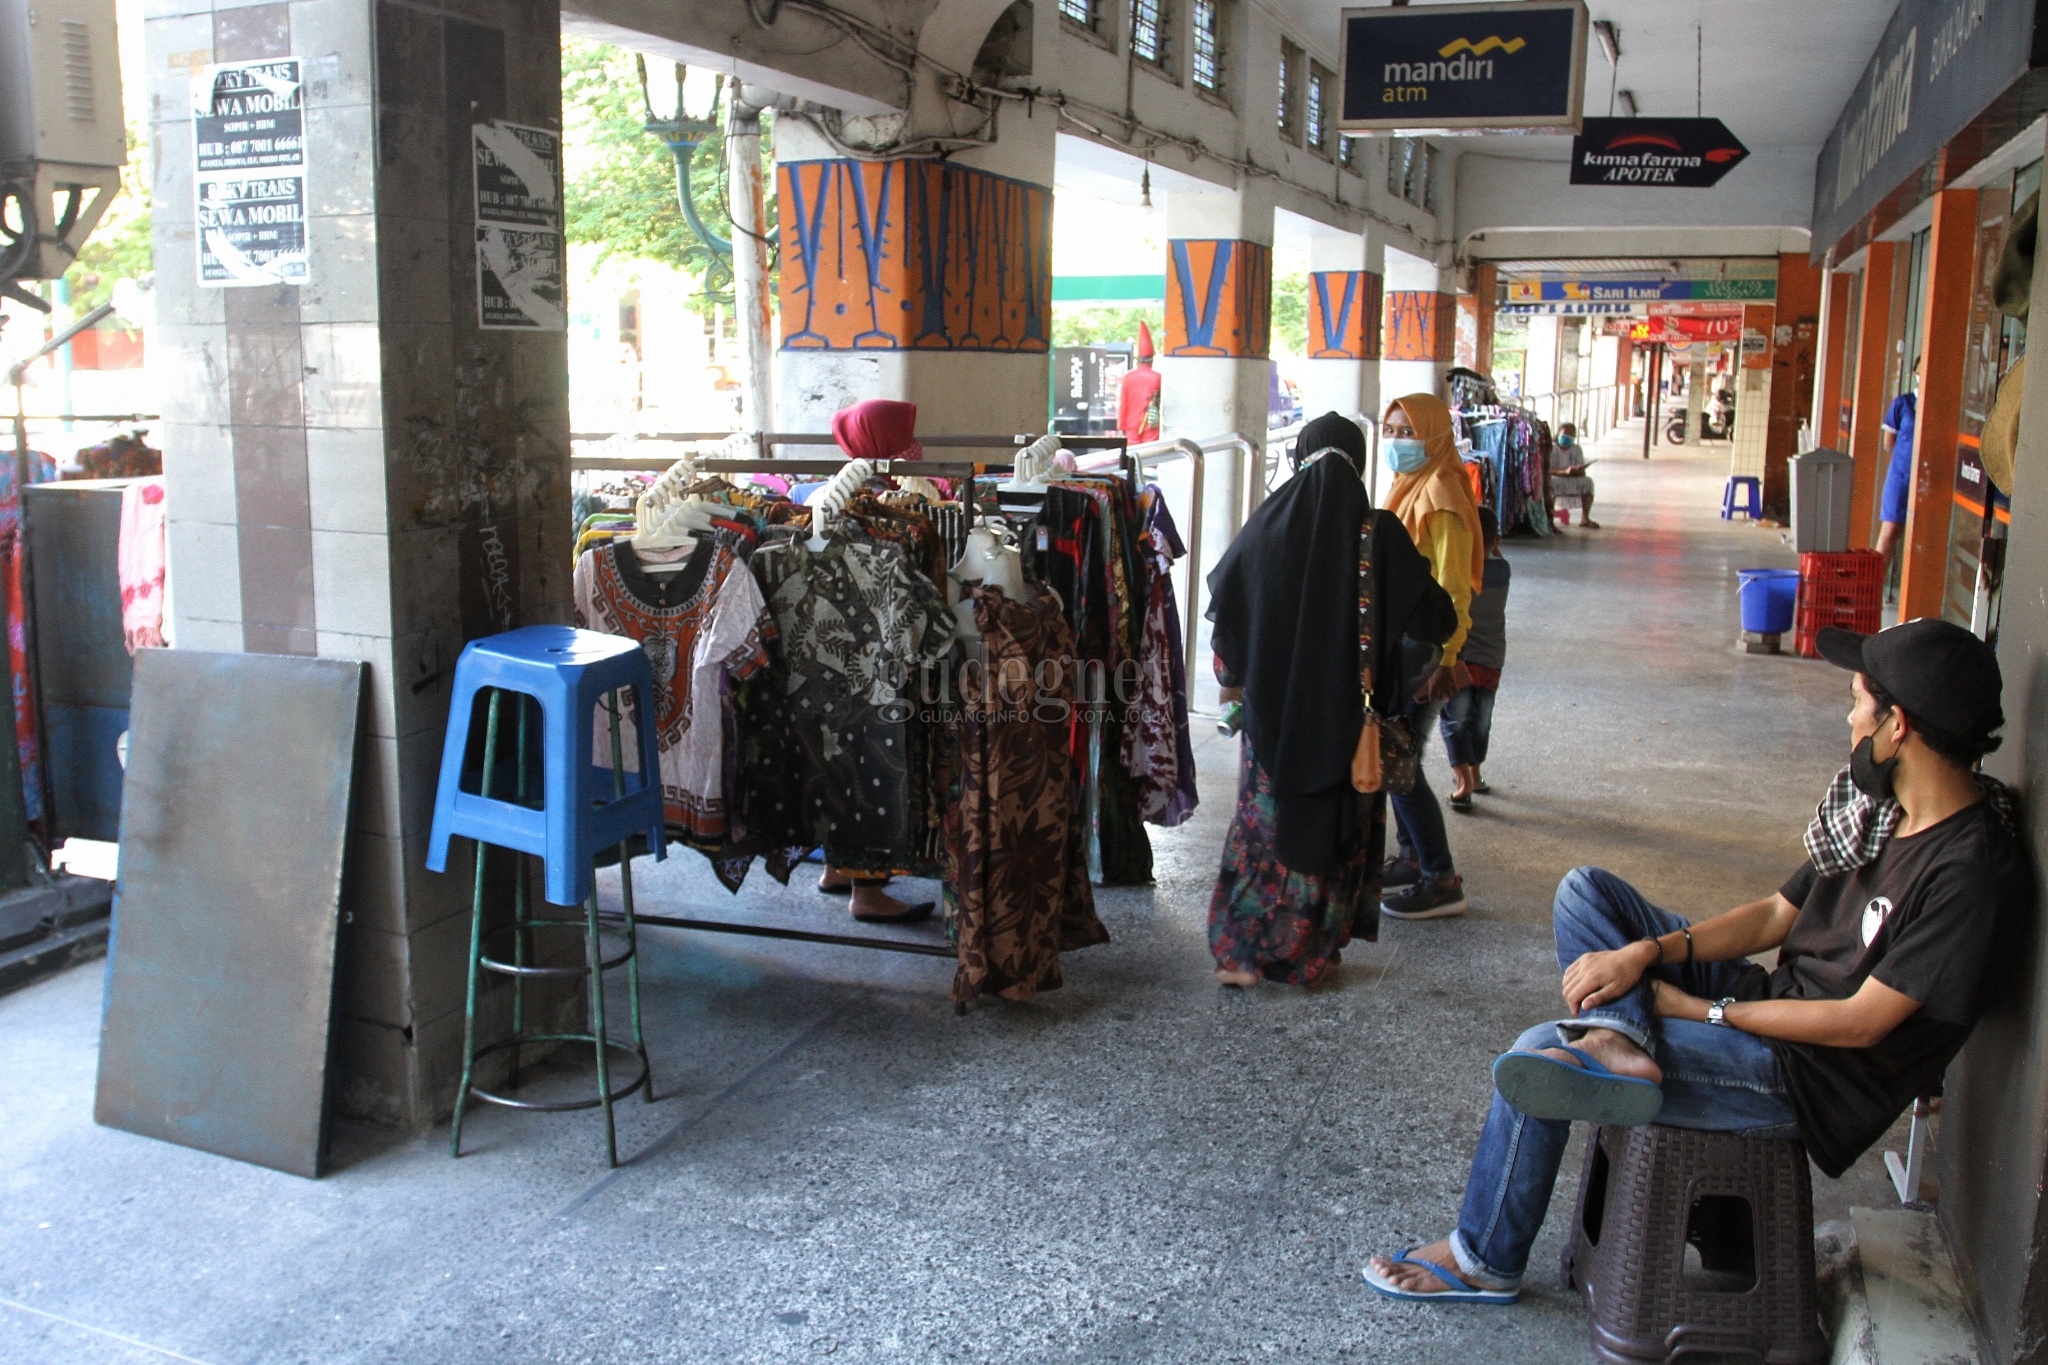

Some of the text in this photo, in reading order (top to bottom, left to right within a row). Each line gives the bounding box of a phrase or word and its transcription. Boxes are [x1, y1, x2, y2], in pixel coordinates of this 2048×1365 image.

[1383, 53, 1494, 84] mandiri
[1382, 86, 1428, 103] atm
[1603, 167, 1679, 183] APOTEK
[248, 178, 296, 198] TRANS
[199, 203, 303, 228] SEWA MOBIL
